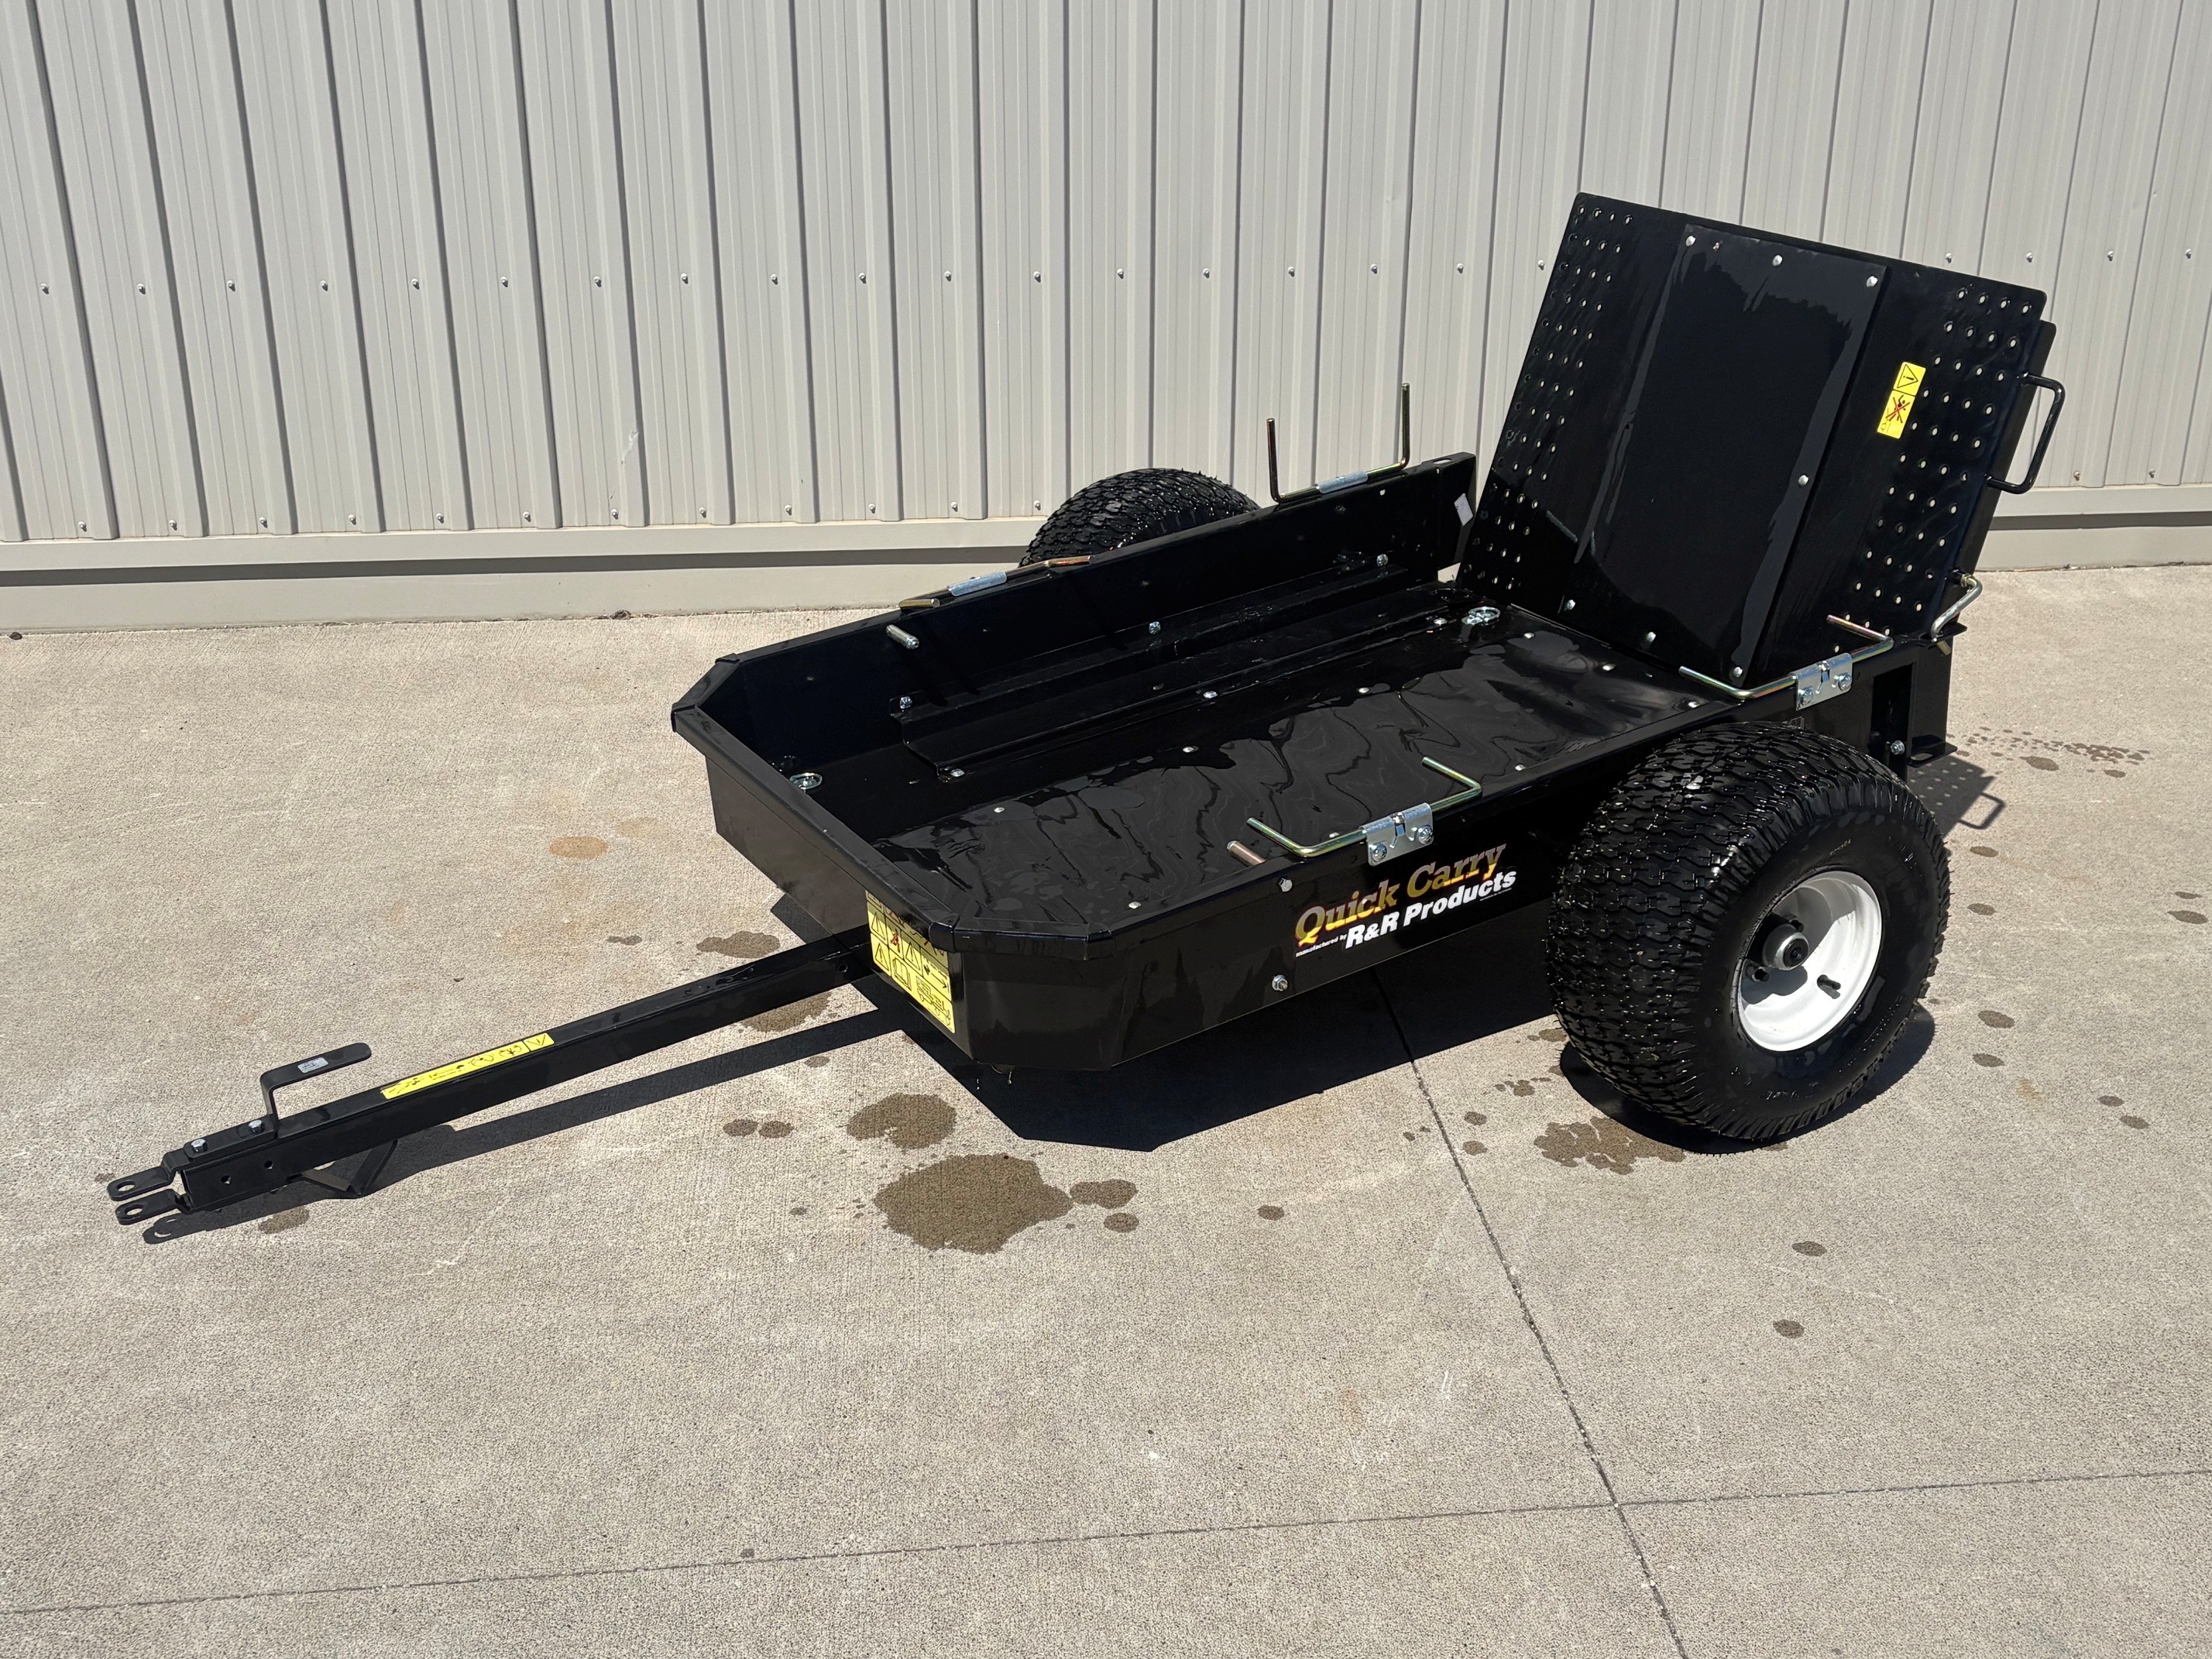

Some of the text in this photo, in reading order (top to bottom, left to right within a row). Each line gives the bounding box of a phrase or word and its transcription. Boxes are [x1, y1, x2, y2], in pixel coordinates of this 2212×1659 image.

[1295, 843, 1506, 947] Quick Carry
[1345, 871, 1516, 950] R&R Products
